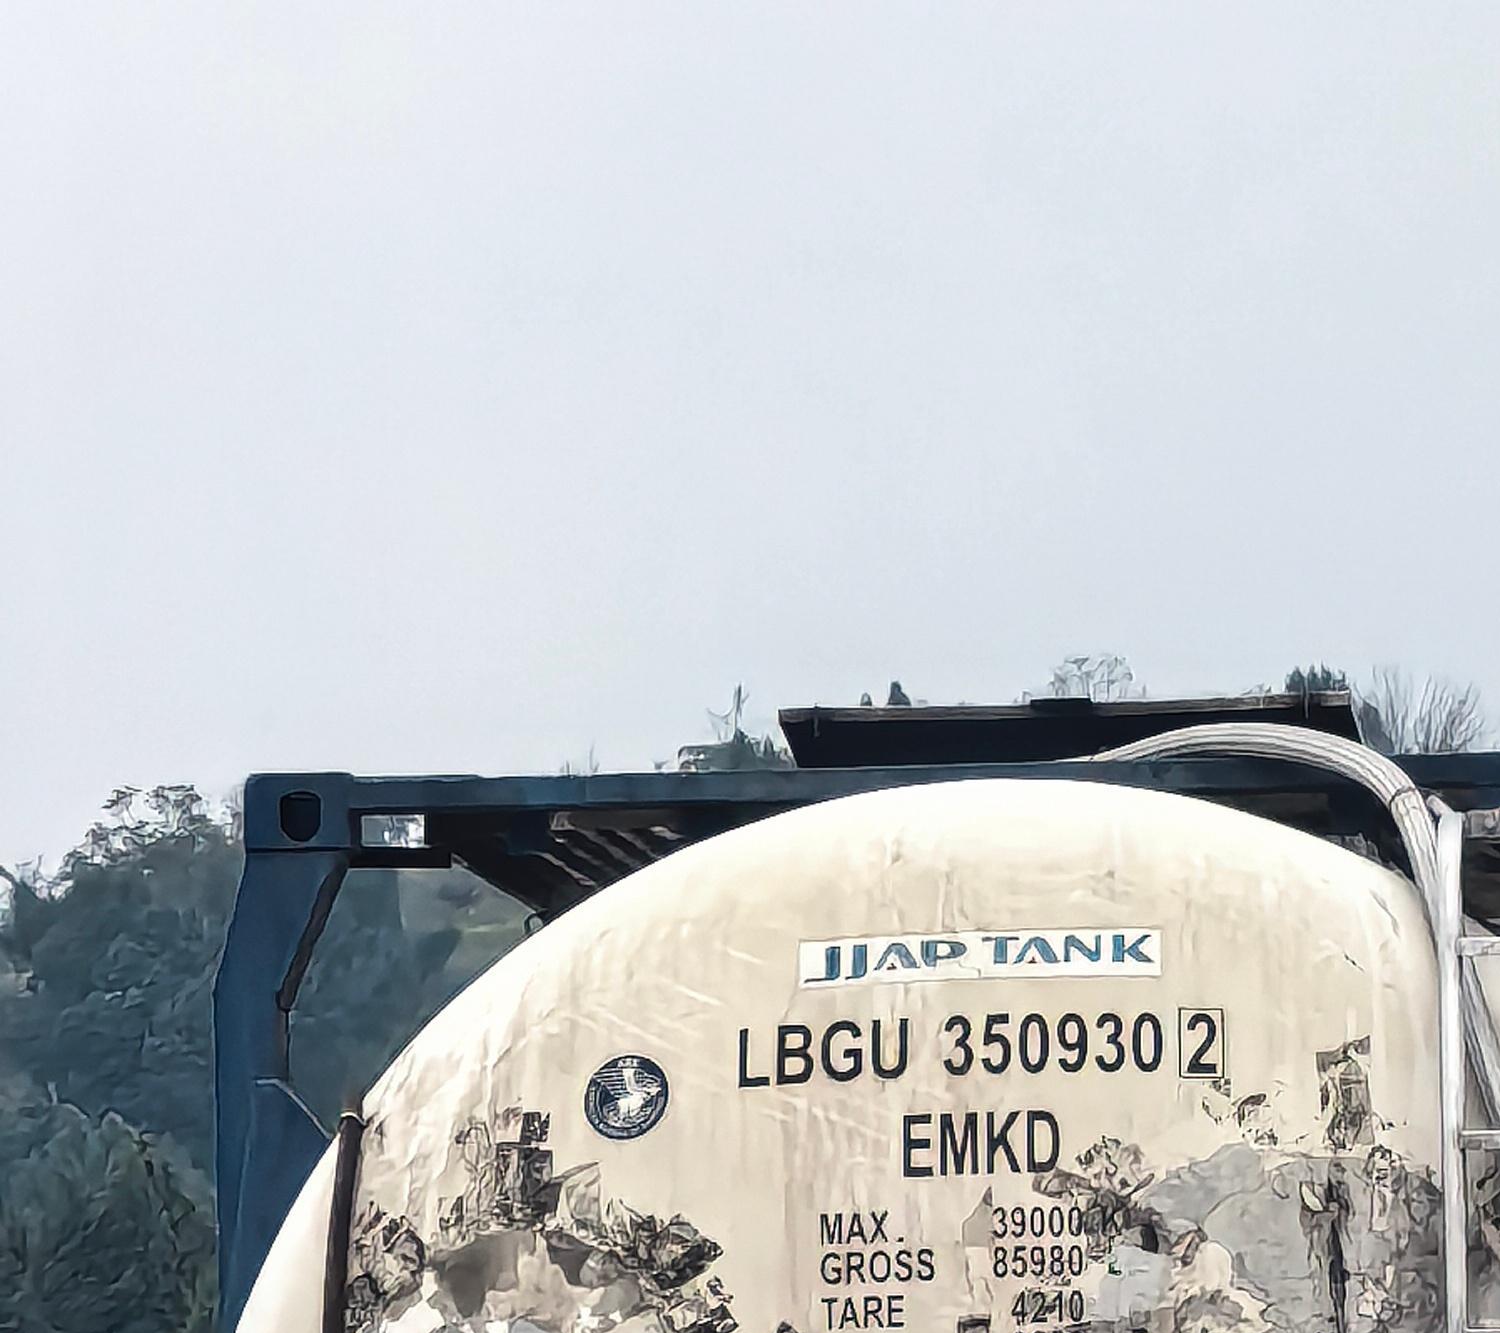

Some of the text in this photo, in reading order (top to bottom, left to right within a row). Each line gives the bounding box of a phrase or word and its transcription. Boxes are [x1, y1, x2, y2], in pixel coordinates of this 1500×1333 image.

[982, 934, 1155, 965] TANK
[738, 1012, 1218, 1088] LBGU 350930 2
[903, 1109, 1061, 1178] EMKD
[819, 1209, 905, 1247] MAX.
[992, 1205, 1083, 1239] 39000
[819, 1248, 936, 1285] GROSS
[992, 1245, 1084, 1278] 85980
[820, 1289, 1085, 1330] TARE 4210
